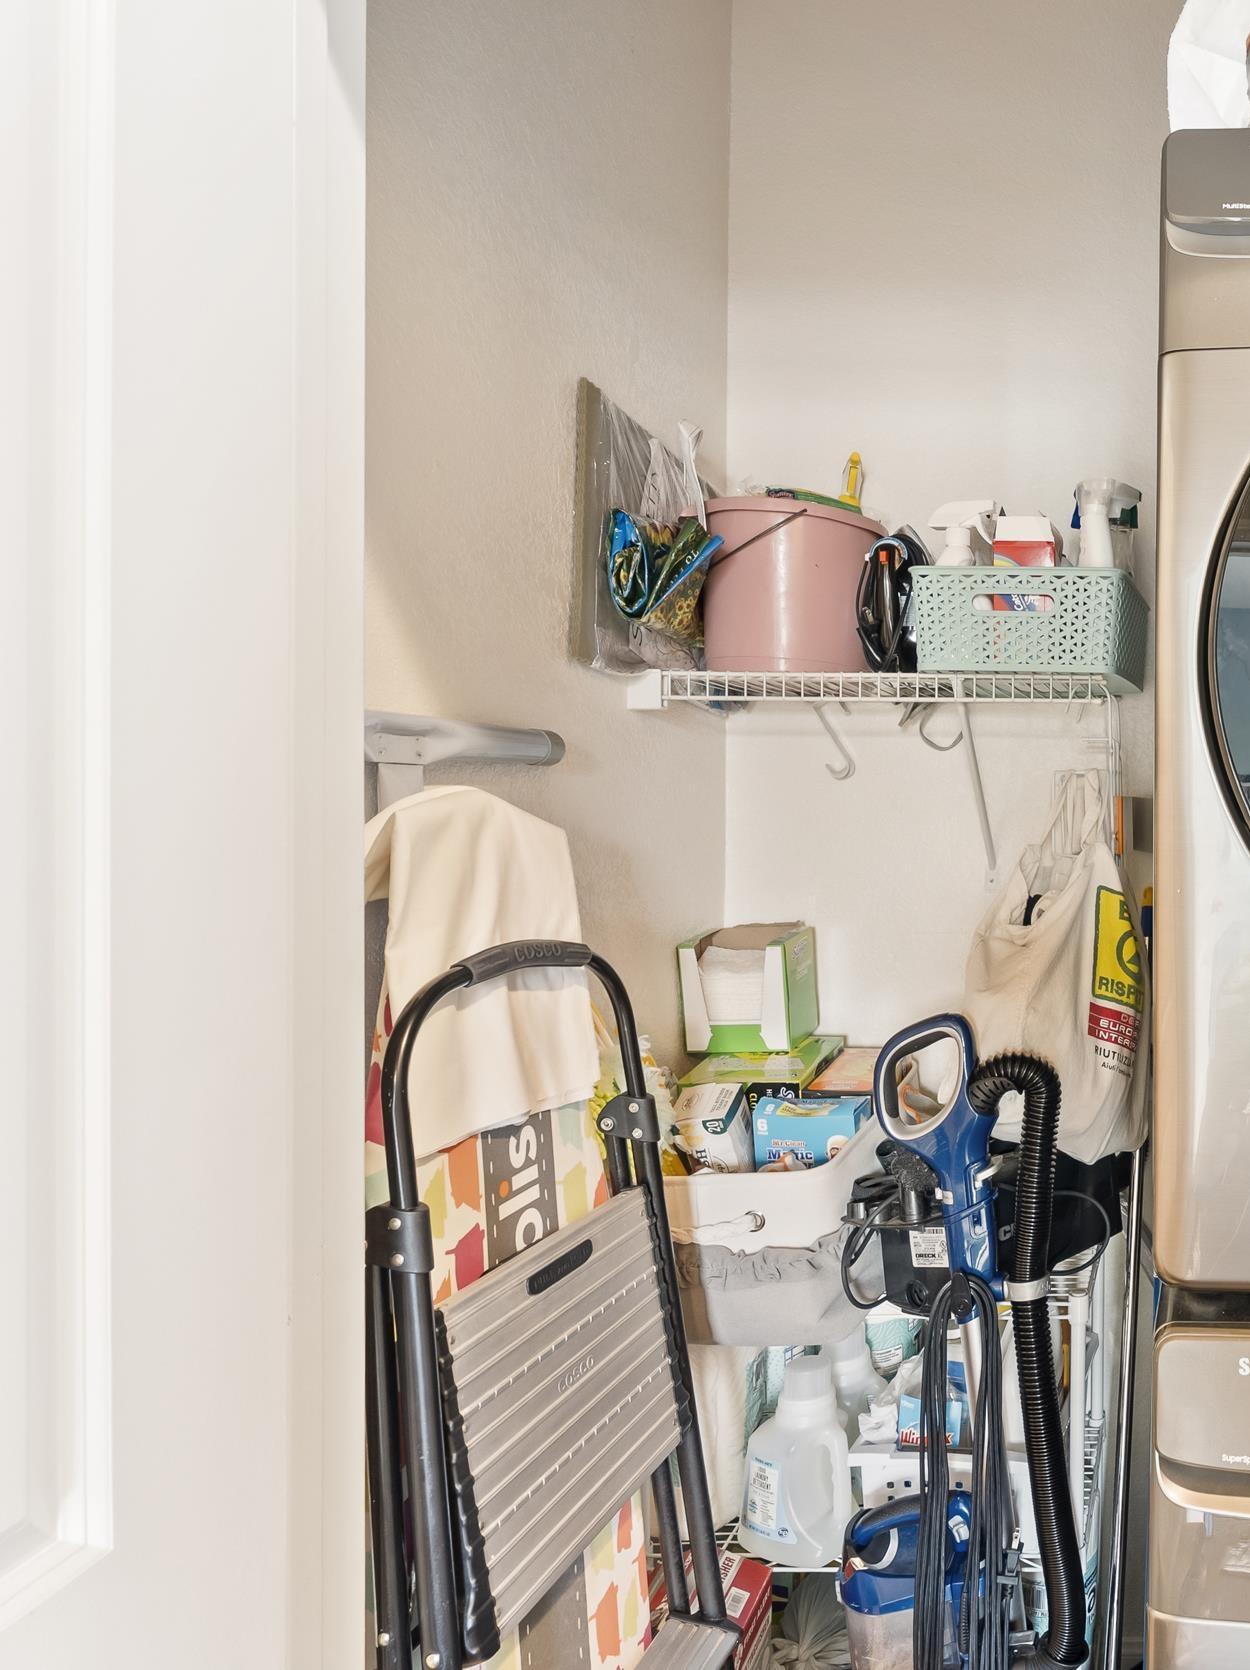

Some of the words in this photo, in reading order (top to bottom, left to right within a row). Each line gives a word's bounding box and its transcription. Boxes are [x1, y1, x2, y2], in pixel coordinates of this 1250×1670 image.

[706, 1120, 720, 1133] 20
[757, 1118, 768, 1132] 6
[767, 1149, 813, 1160] Mic
